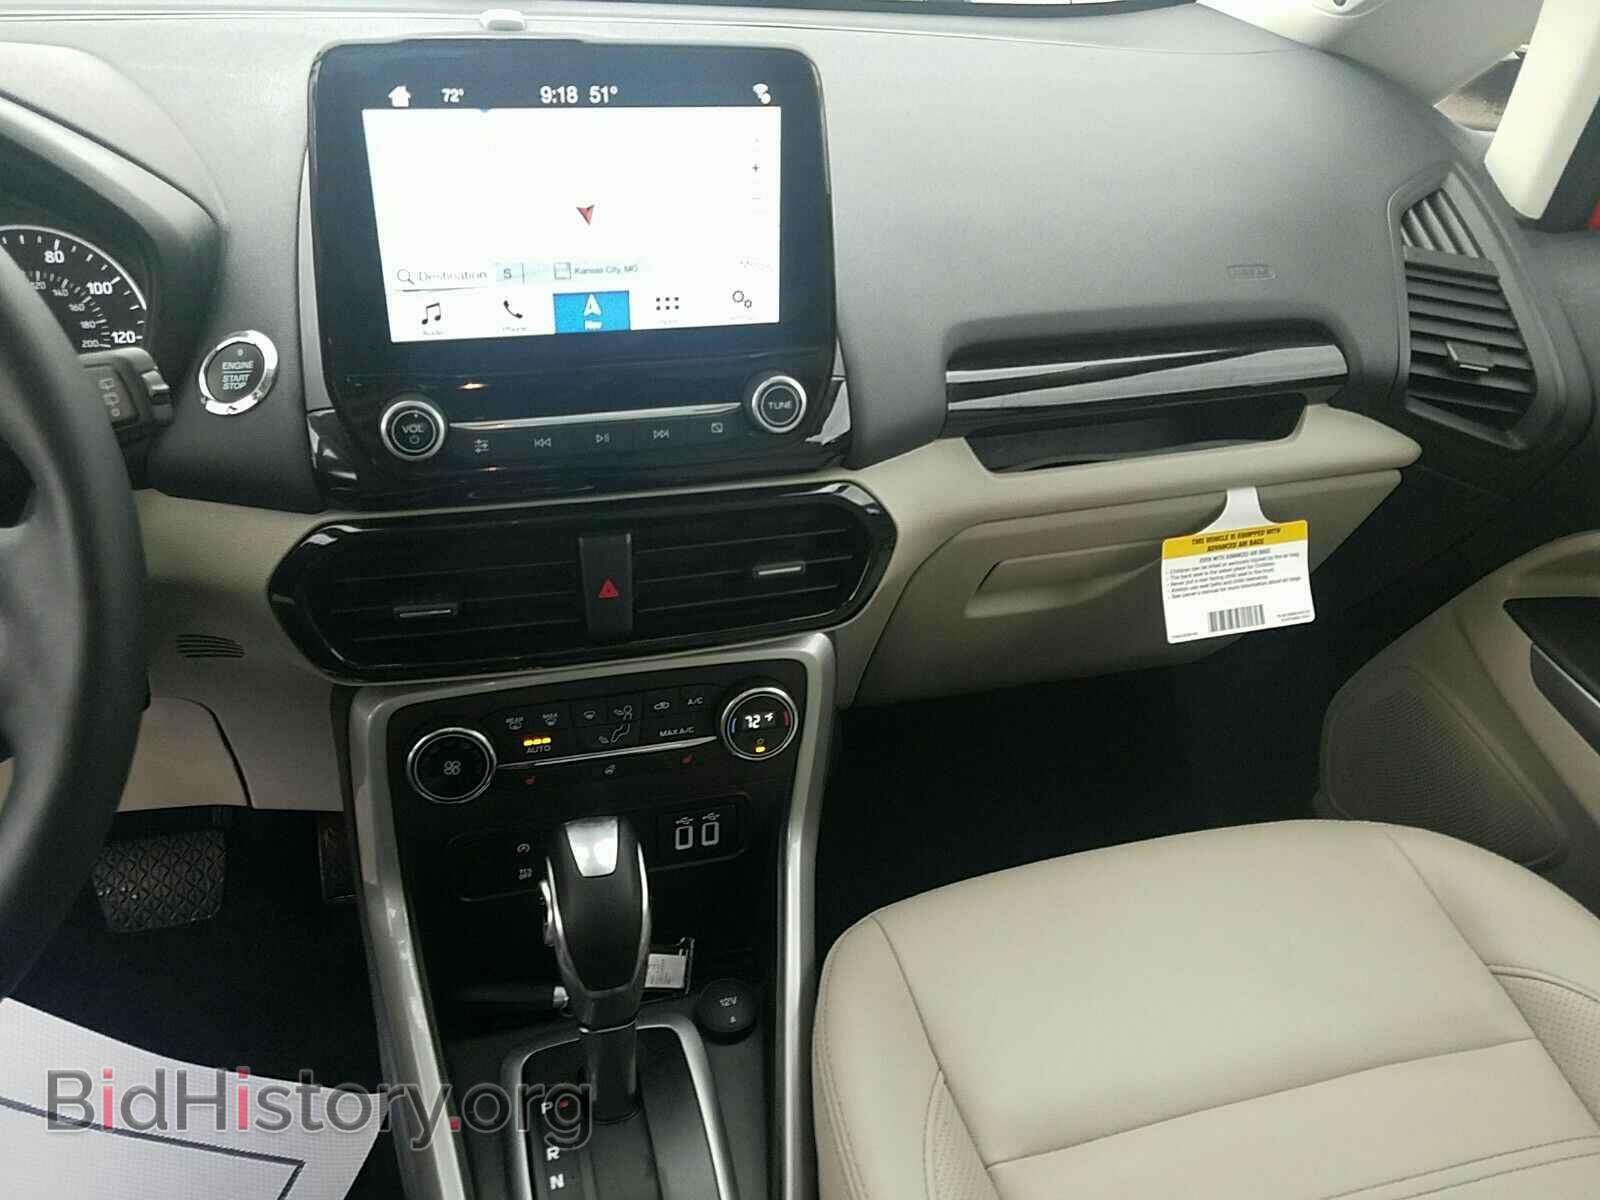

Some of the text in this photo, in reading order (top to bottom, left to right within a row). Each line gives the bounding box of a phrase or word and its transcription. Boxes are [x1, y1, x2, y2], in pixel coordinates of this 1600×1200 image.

[540, 86, 578, 104] 9:18
[44, 250, 65, 263] 80
[503, 268, 512, 280] S
[86, 282, 113, 295] 100
[111, 331, 136, 344] 120
[81, 339, 99, 348] 200
[222, 360, 254, 370] ENGINE
[222, 374, 250, 383] START
[222, 382, 247, 390] STOP
[768, 400, 793, 409] TUNE
[401, 424, 424, 433] VOL
[688, 697, 703, 705] A/C
[745, 714, 760, 729] 72
[660, 728, 678, 737] MAX
[526, 744, 551, 753] AUTO
[541, 1101, 553, 1115] P
[546, 1146, 560, 1161] R
[549, 1173, 565, 1191] N
